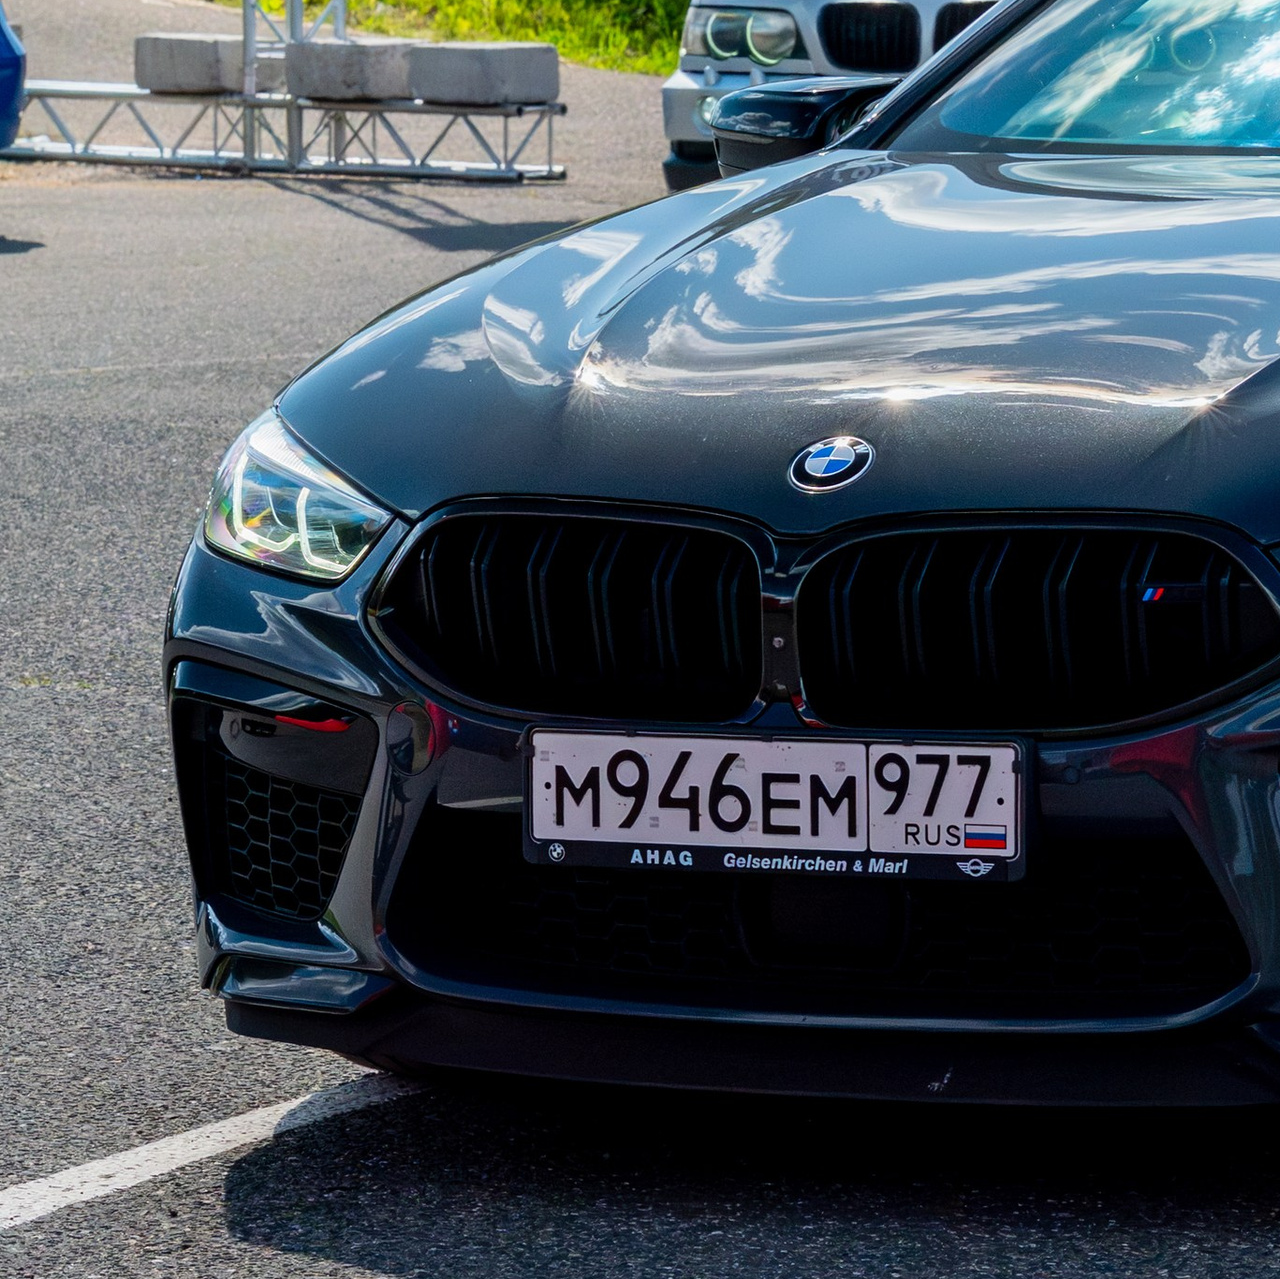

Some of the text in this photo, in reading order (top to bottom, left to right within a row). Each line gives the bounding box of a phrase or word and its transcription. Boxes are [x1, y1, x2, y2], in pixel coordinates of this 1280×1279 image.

[873, 752, 992, 818] 977
[903, 823, 962, 847] RUS
[630, 848, 908, 874] AHAG Gelsenkirchen & Marl
